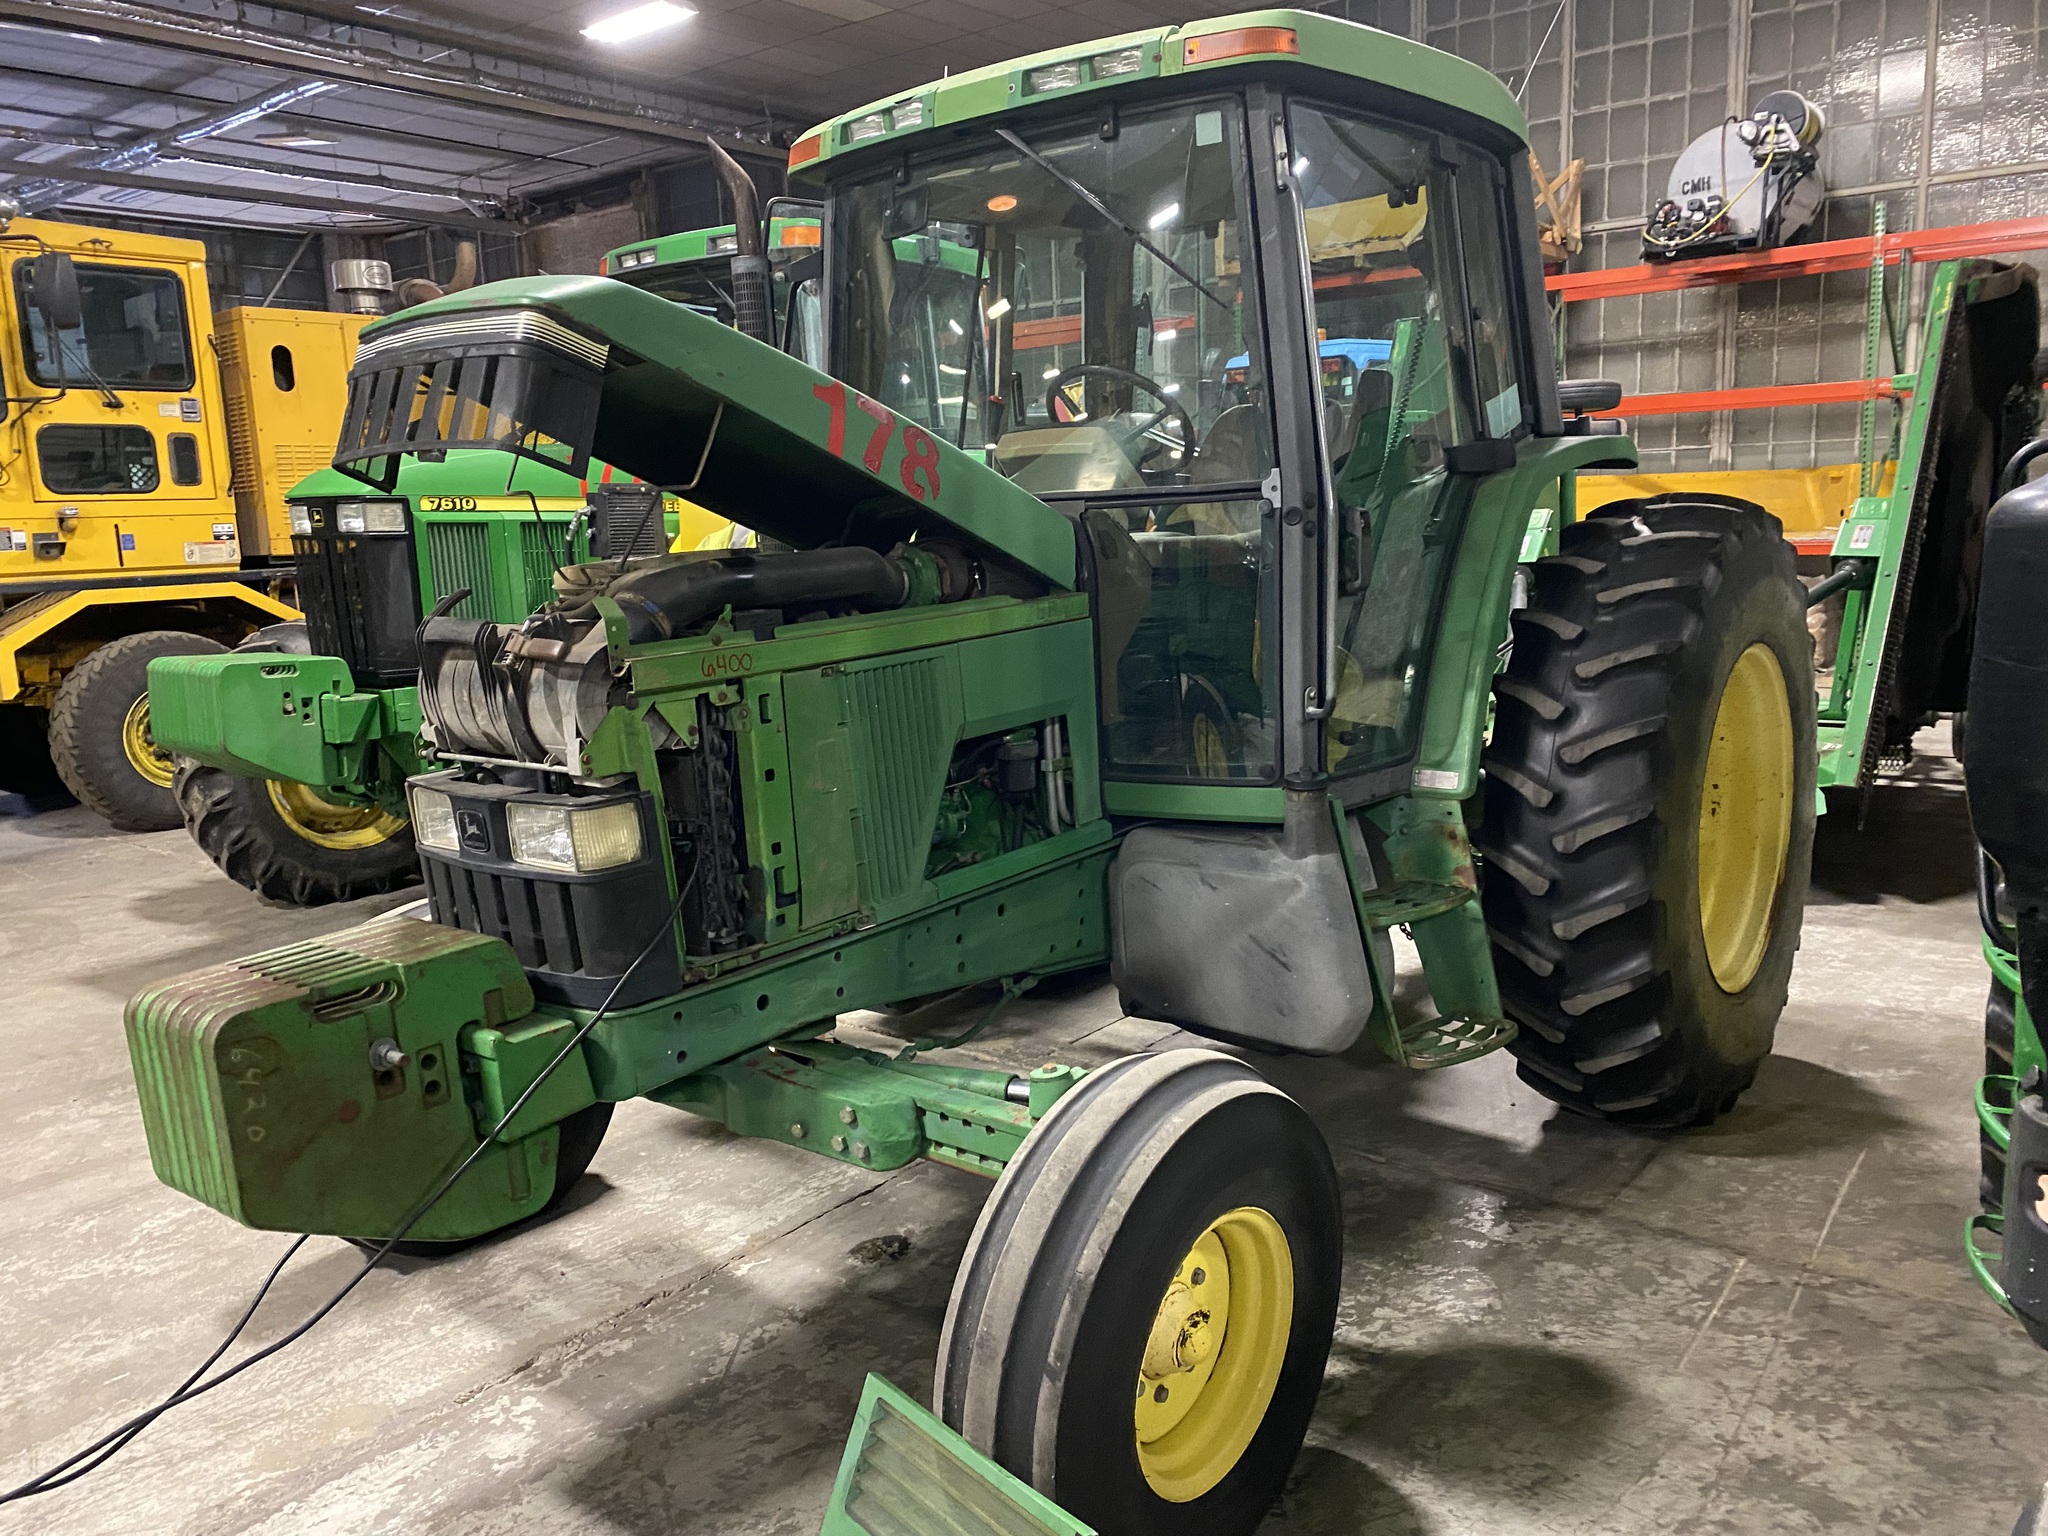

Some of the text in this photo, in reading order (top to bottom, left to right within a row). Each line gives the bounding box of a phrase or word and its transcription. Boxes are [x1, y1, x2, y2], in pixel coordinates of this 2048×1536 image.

[1682, 175, 1712, 195] CMH
[427, 496, 477, 511] 7610
[701, 653, 753, 678] 6400
